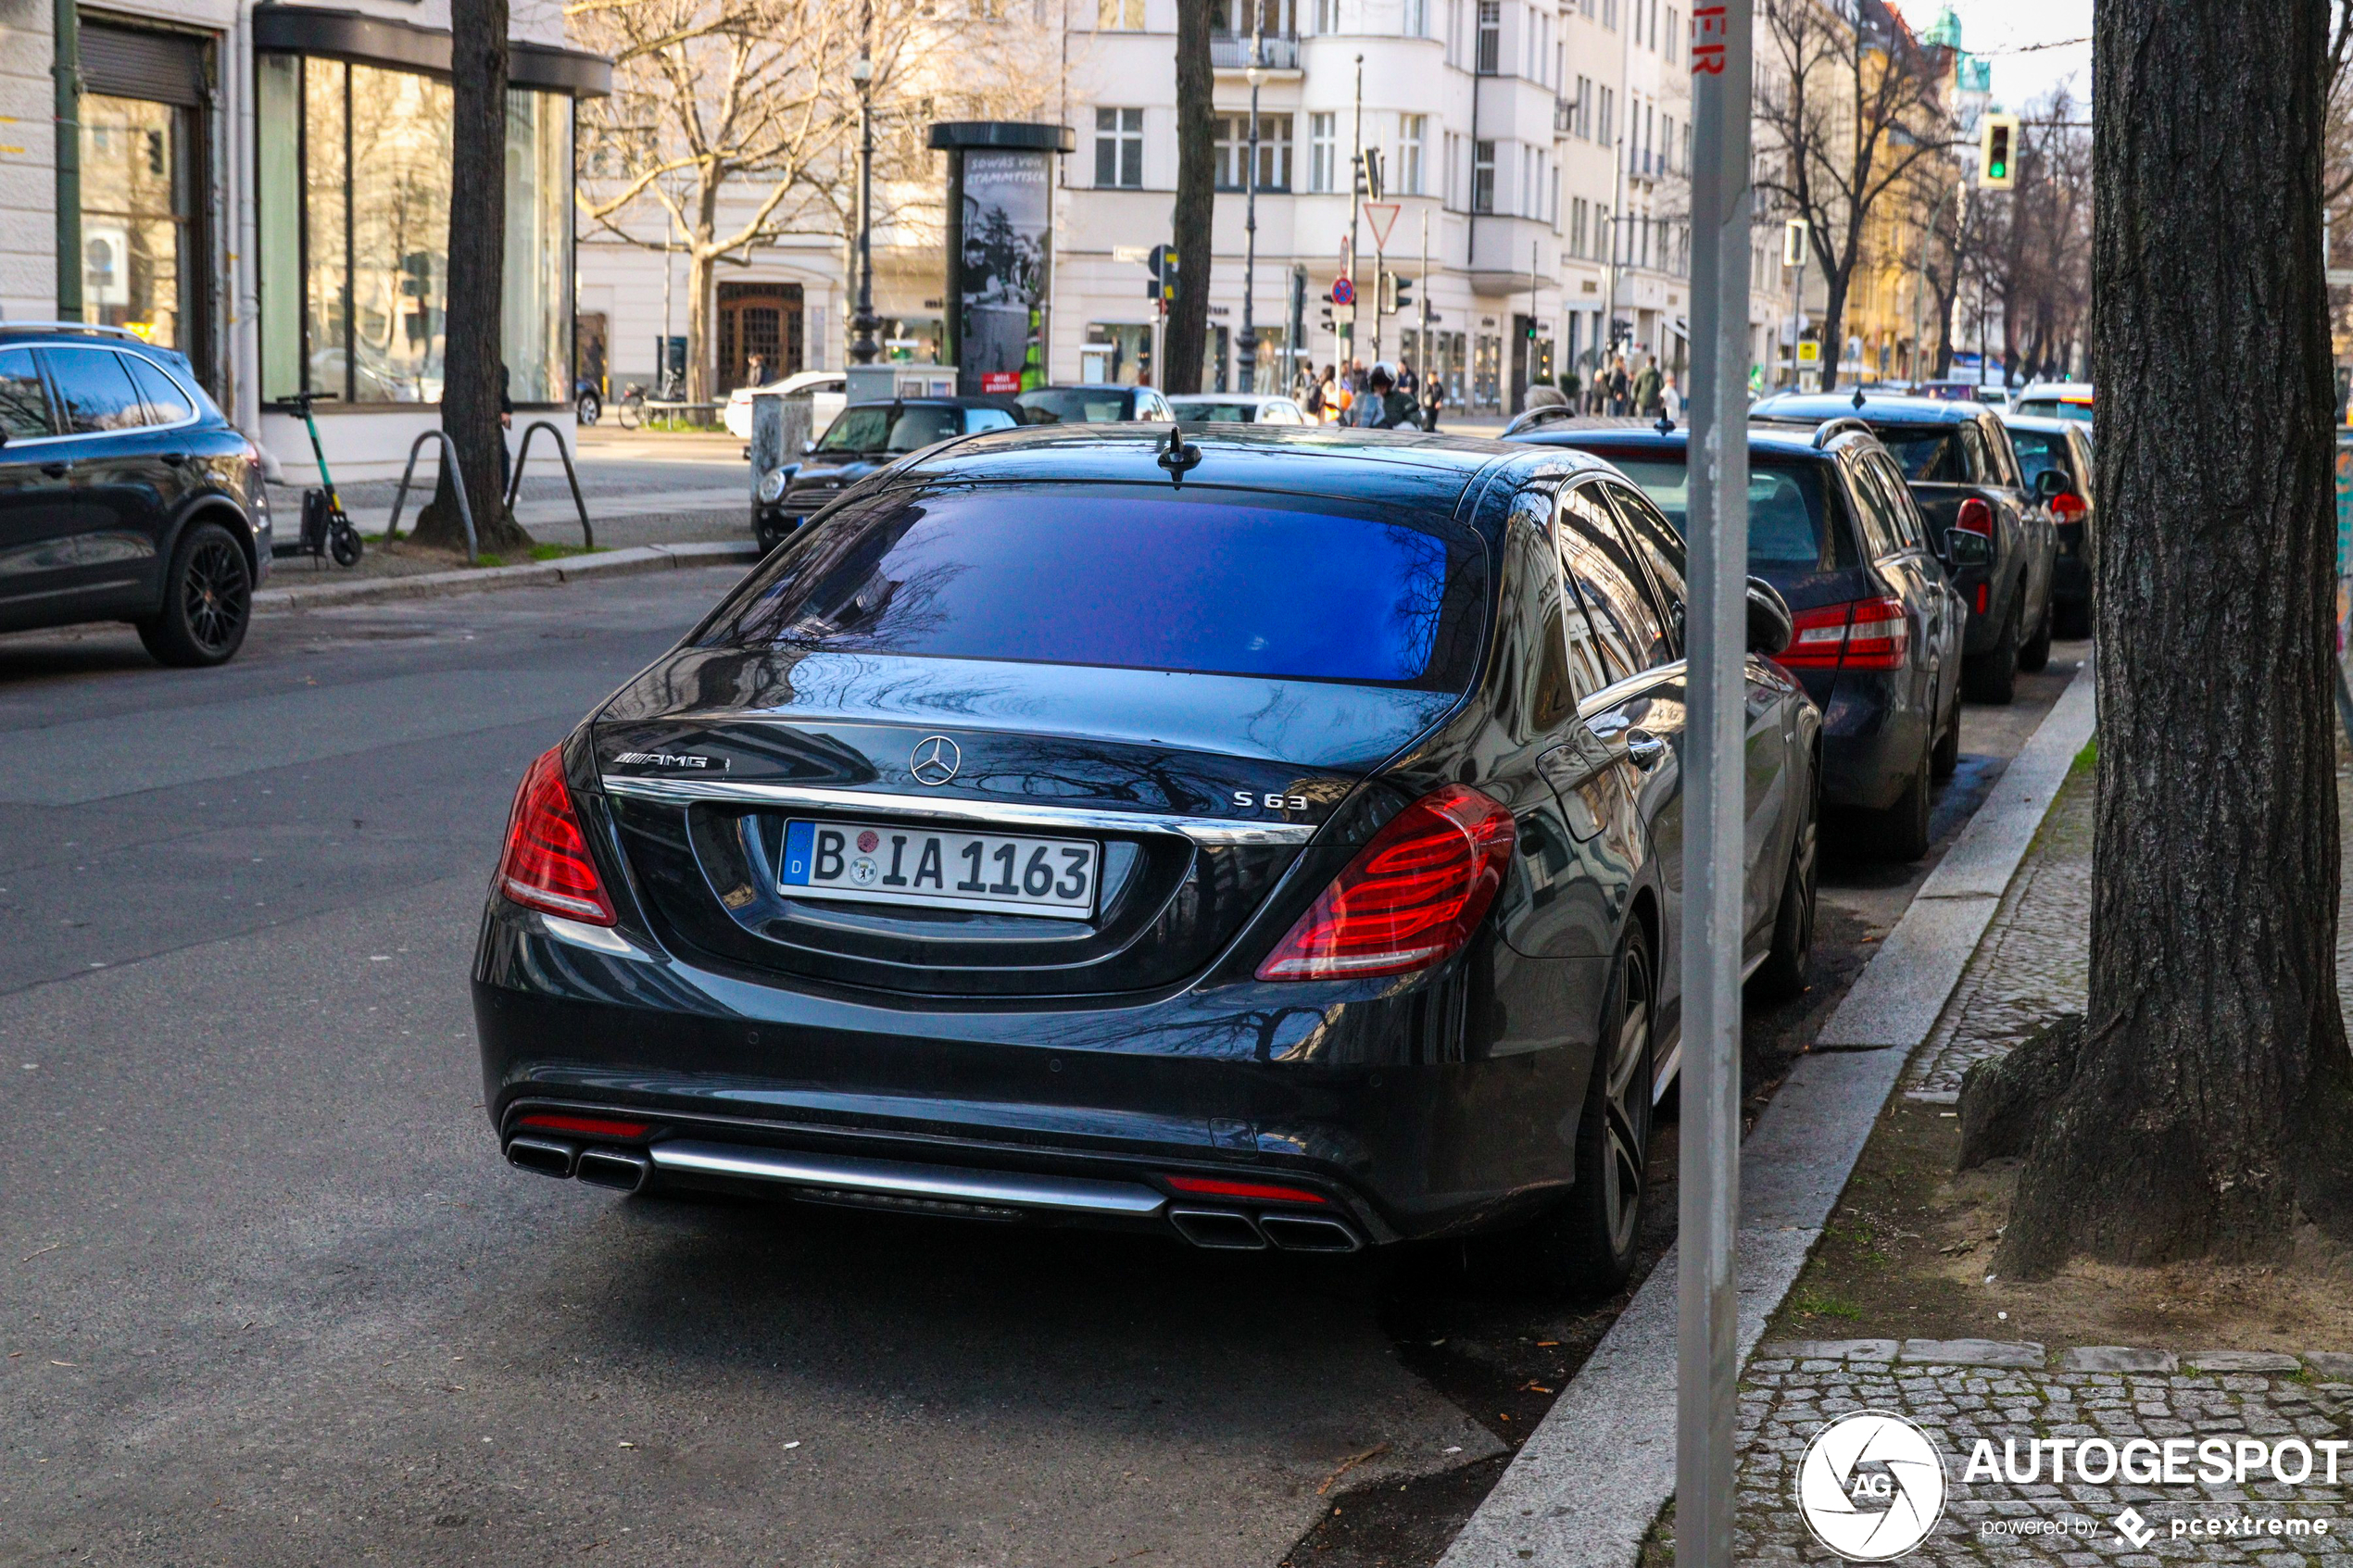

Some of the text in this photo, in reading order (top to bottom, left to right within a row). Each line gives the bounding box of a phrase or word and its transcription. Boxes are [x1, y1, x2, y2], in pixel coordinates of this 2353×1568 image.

[643, 753, 708, 768] AMG
[1233, 791, 1307, 810] S 63
[791, 859, 802, 873] D
[814, 830, 845, 880] B
[883, 835, 943, 889] IA
[958, 841, 1089, 900] 1163
